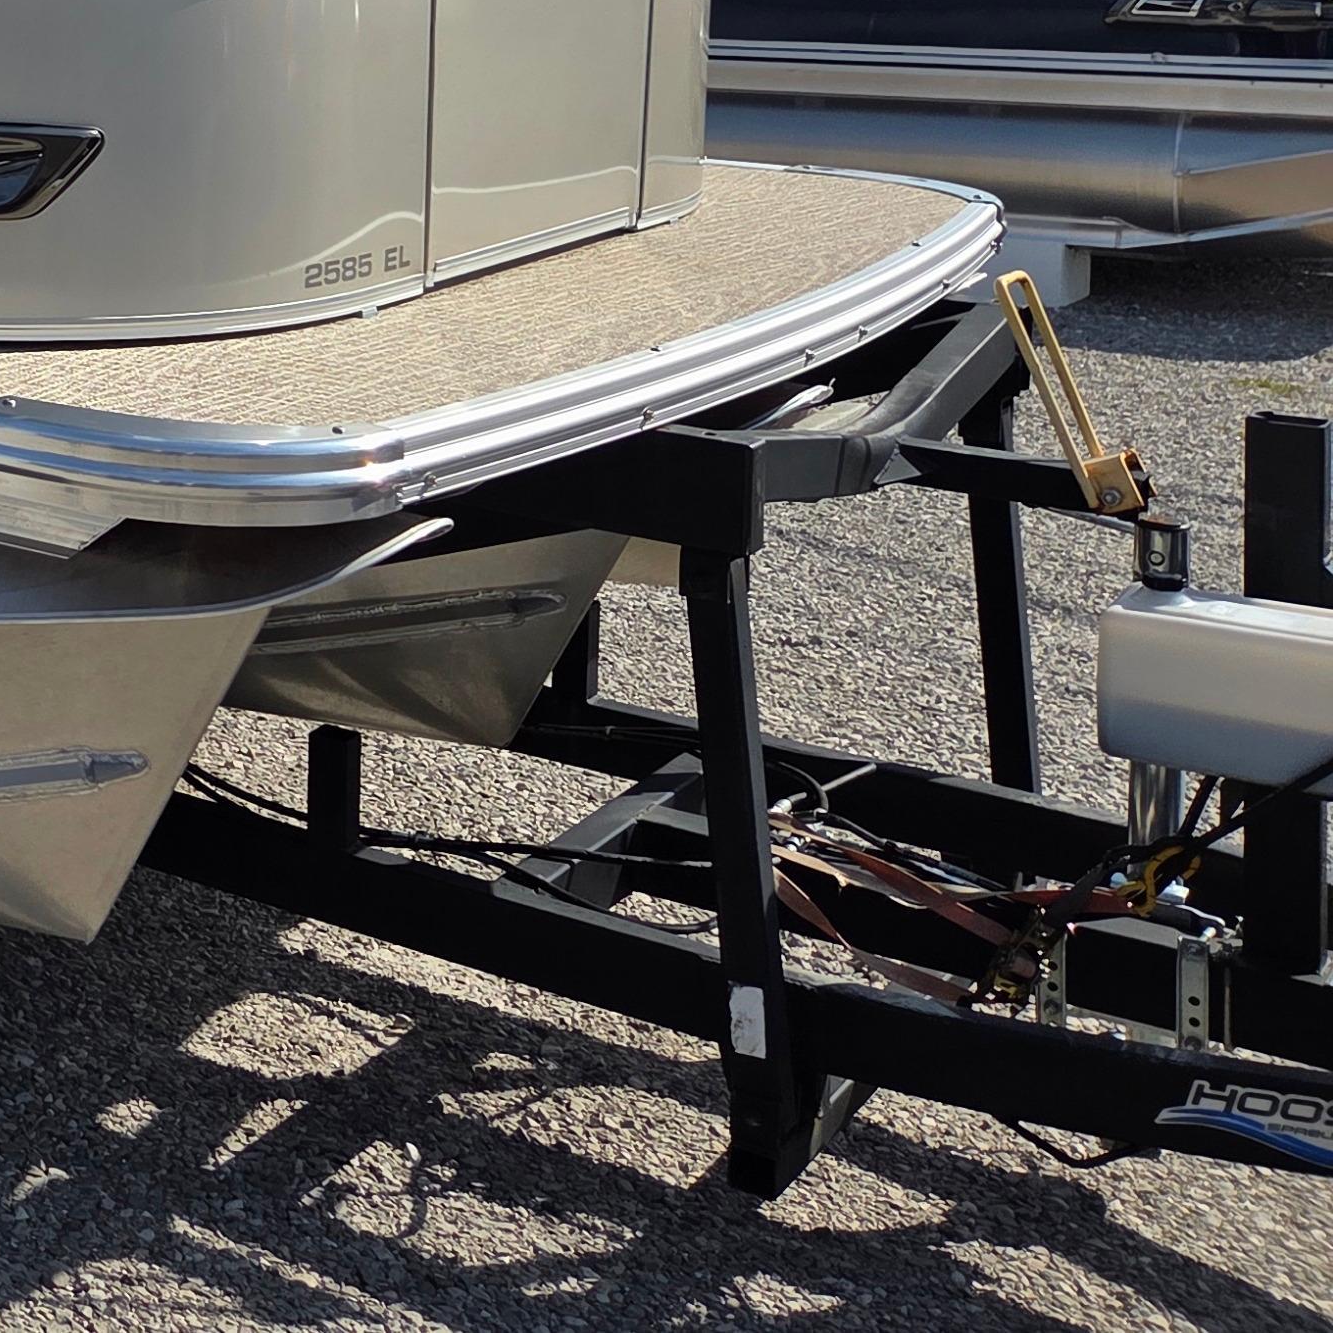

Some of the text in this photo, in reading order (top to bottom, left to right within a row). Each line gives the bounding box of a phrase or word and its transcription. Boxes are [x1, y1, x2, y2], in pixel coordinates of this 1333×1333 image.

[304, 245, 411, 289] 2585 EL
[1191, 1083, 1333, 1126] HOO
